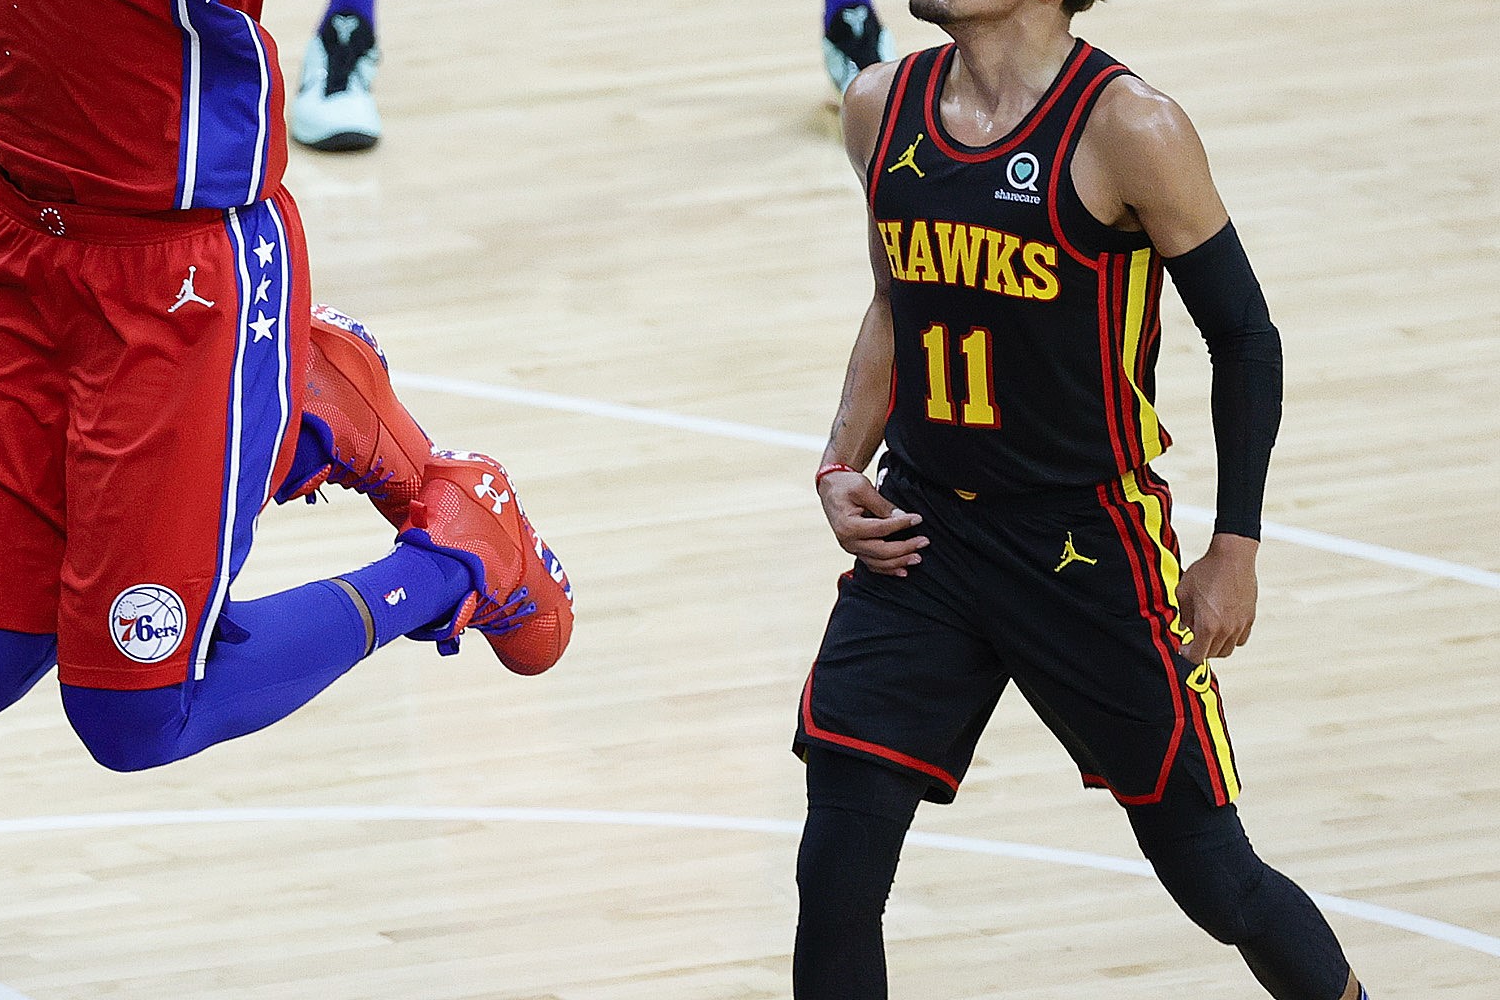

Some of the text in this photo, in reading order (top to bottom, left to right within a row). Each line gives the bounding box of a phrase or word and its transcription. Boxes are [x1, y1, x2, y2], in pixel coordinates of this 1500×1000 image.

[994, 188, 1042, 205] sharecare
[876, 218, 1062, 302] HAWKS
[919, 321, 1003, 430] 11
[119, 614, 179, 643] 76ers
